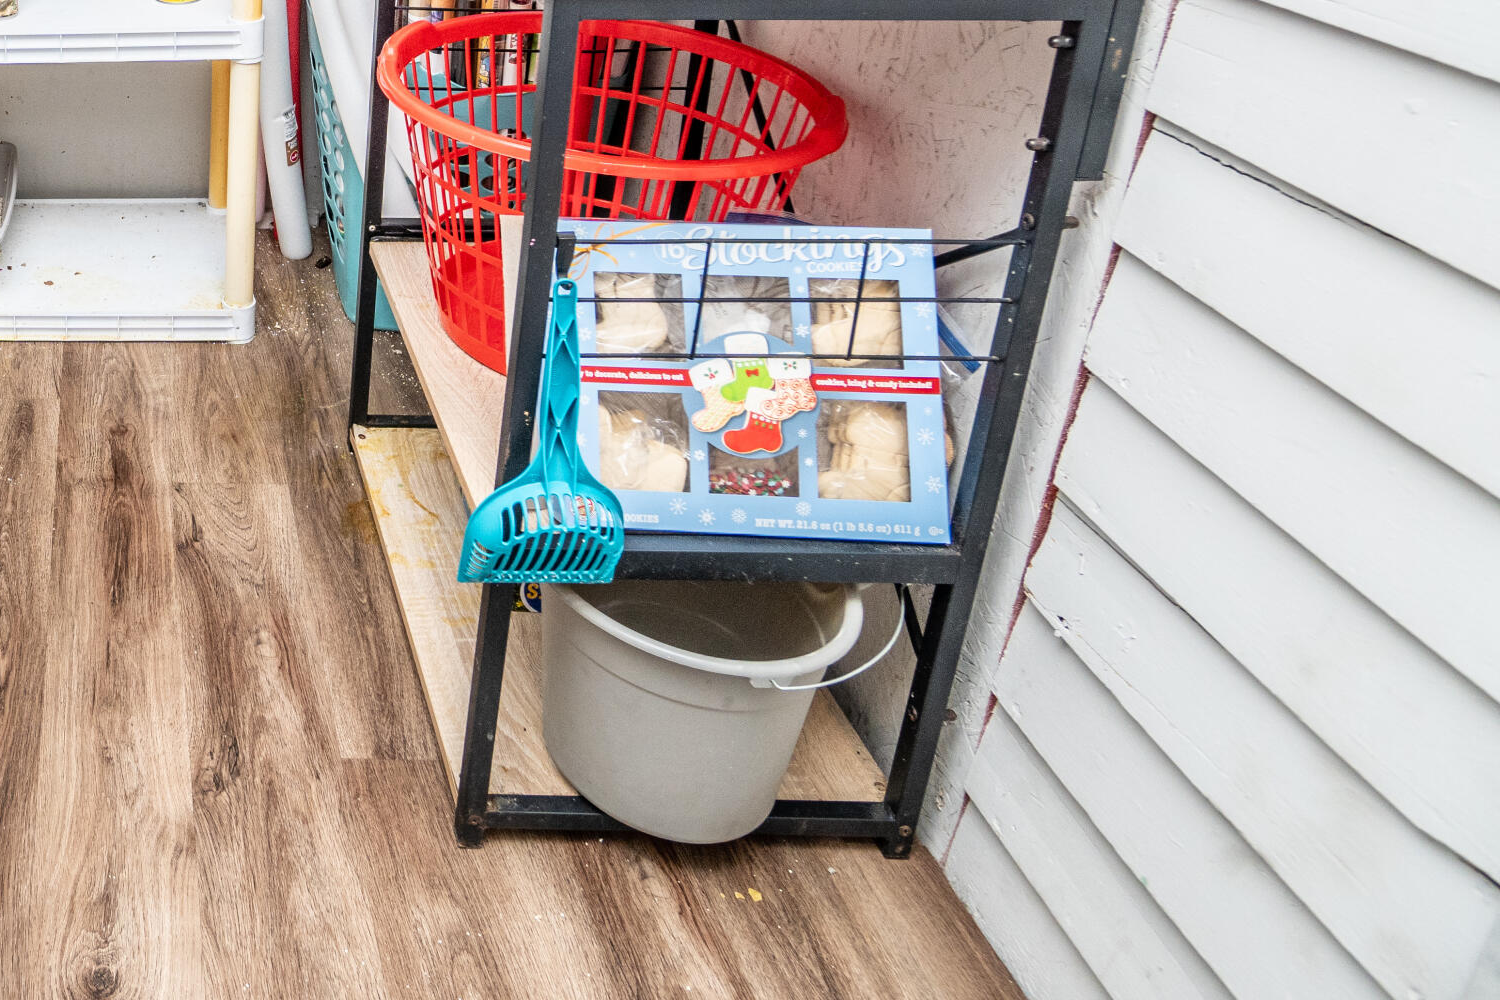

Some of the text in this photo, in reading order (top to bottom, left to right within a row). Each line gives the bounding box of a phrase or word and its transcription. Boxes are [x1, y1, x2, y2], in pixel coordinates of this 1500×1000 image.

[660, 225, 906, 274] 16 Stockings
[806, 261, 862, 273] COOKIES
[624, 514, 659, 524] OOKIES
[755, 518, 775, 528] NET
